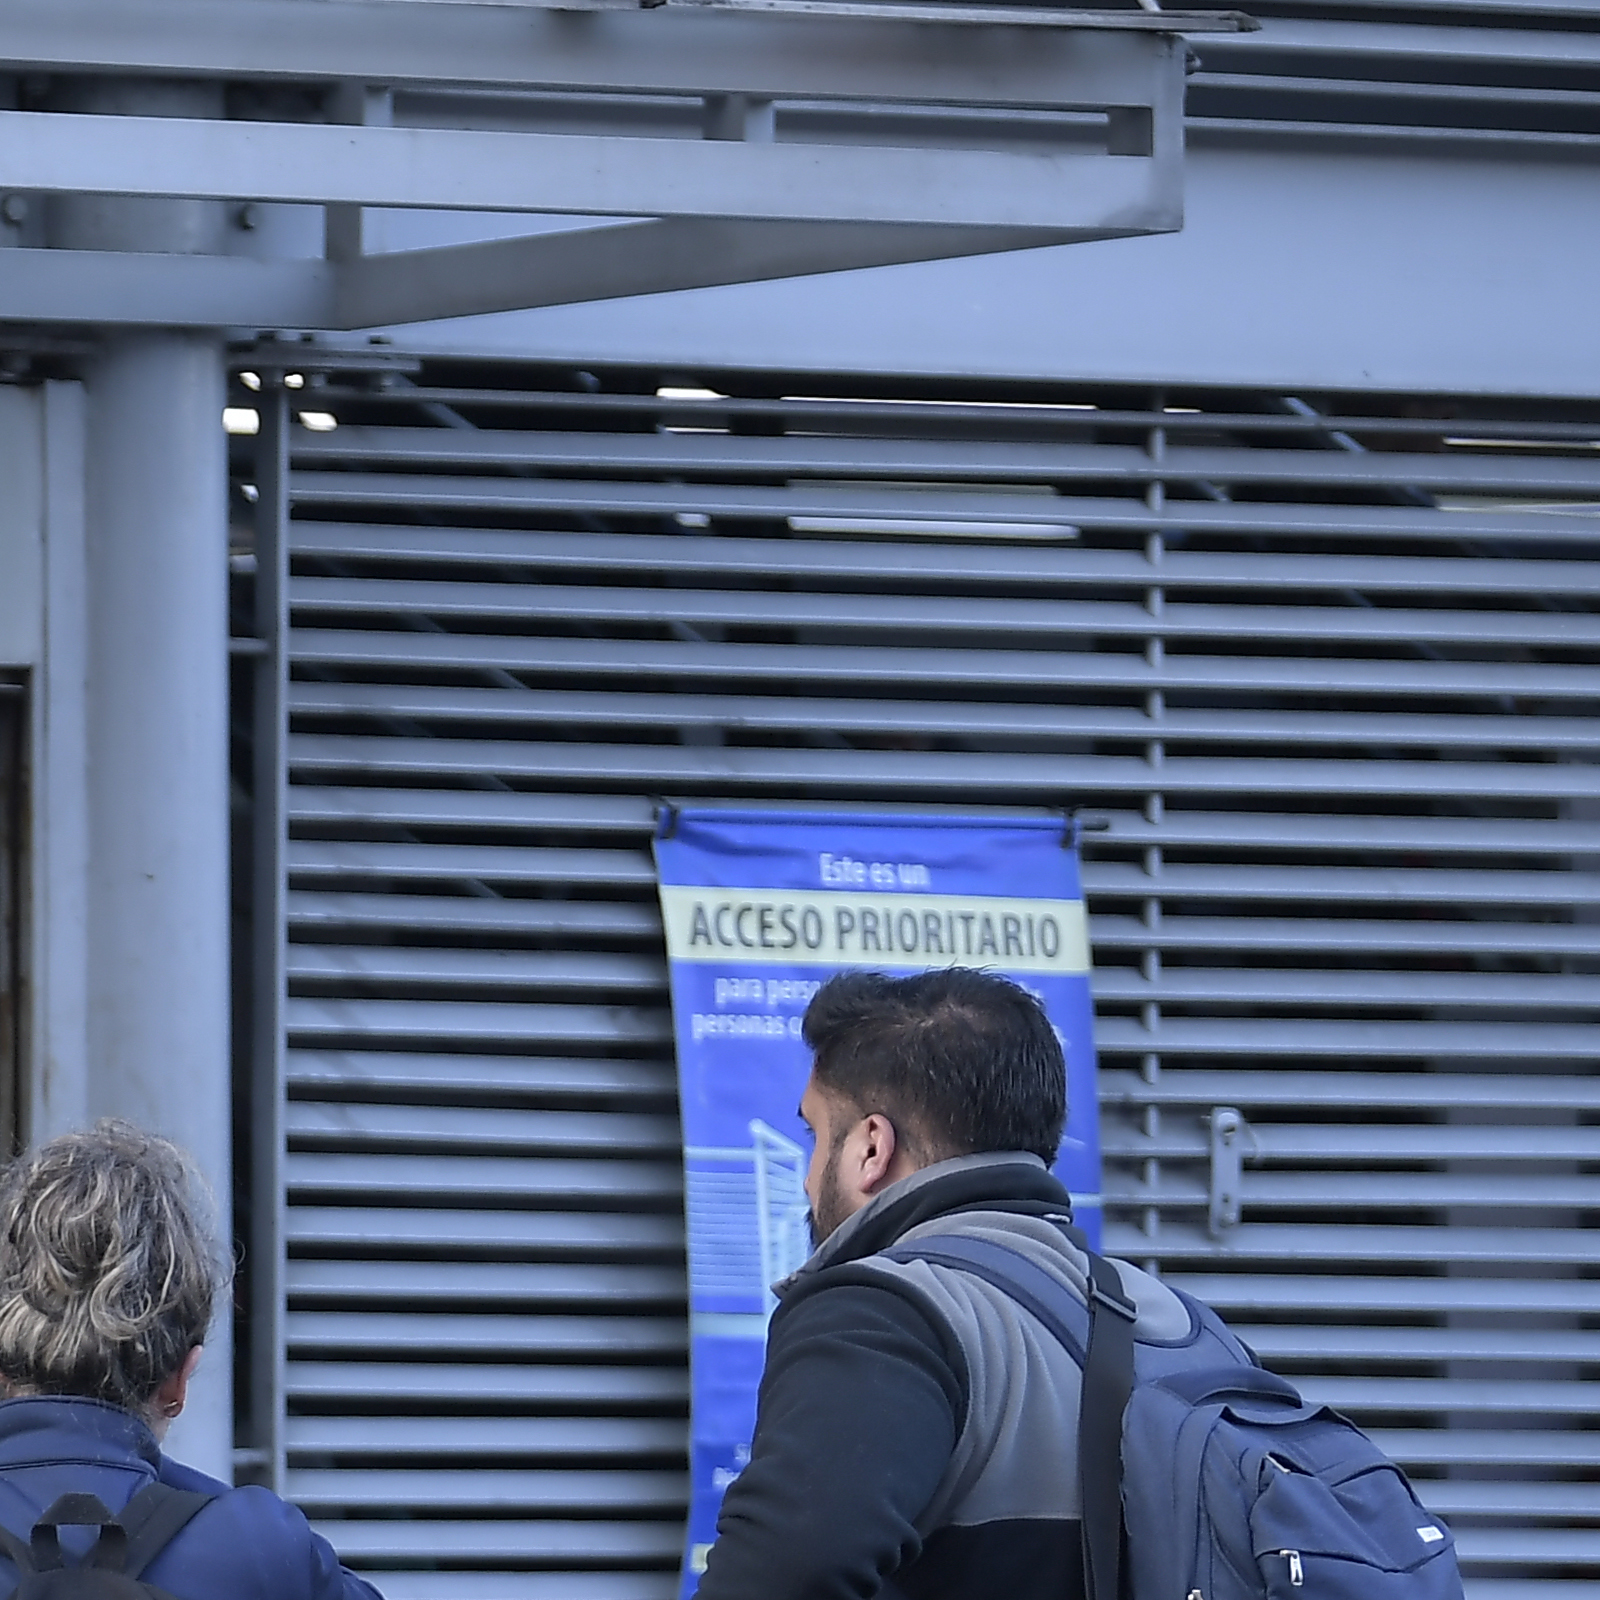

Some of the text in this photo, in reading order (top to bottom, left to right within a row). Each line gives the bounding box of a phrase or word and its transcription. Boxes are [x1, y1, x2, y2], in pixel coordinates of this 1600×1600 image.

[820, 852, 930, 885] Este es un
[689, 905, 1061, 958] ACCESO PRIORITARIO
[714, 977, 763, 1003] para
[692, 1012, 785, 1040] personas
